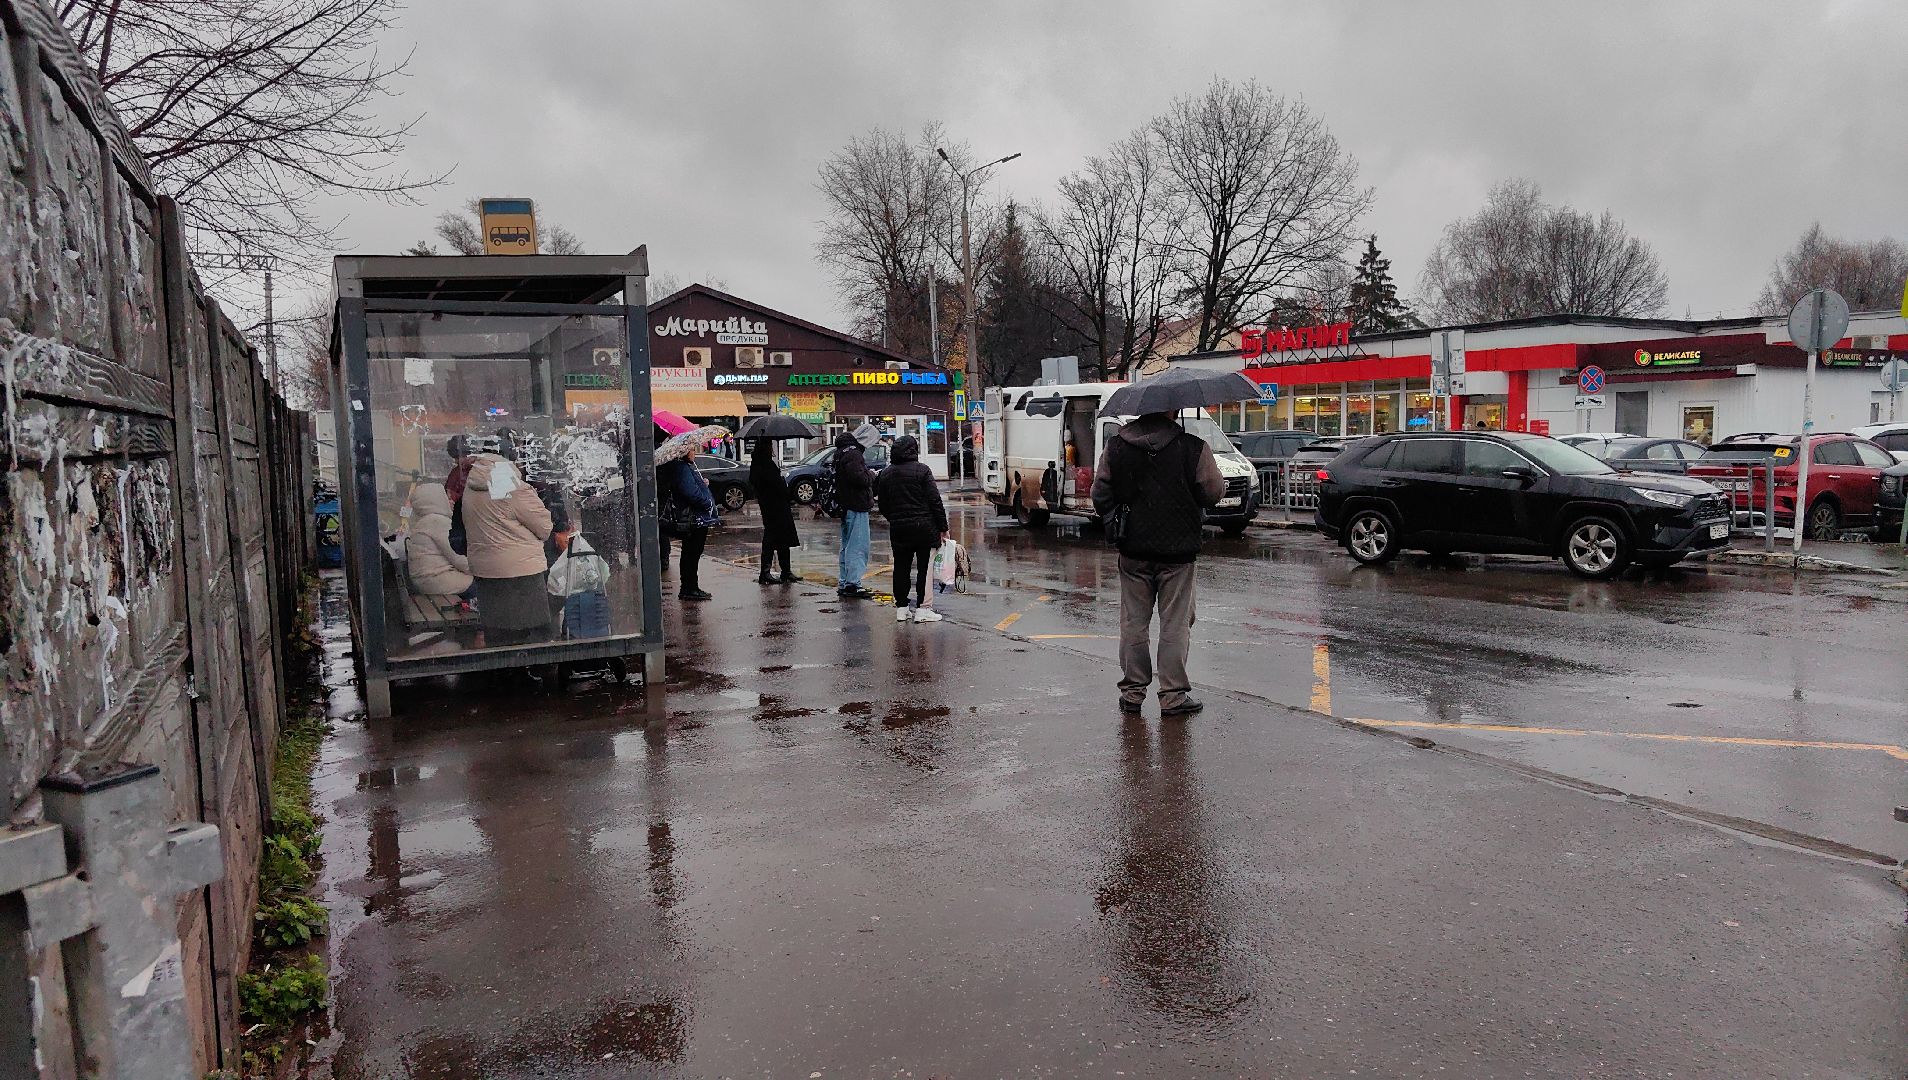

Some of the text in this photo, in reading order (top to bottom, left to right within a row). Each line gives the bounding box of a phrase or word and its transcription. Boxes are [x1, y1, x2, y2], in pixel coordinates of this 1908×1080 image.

[655, 316, 768, 337] Марийка
[720, 335, 766, 343] ПРОДУКТЫ
[1267, 322, 1352, 351] МАГНИТ
[1653, 351, 1700, 360] ВЕЛИКАТЕС
[787, 371, 947, 385] АПТЕКА ПИВО РЫБА
